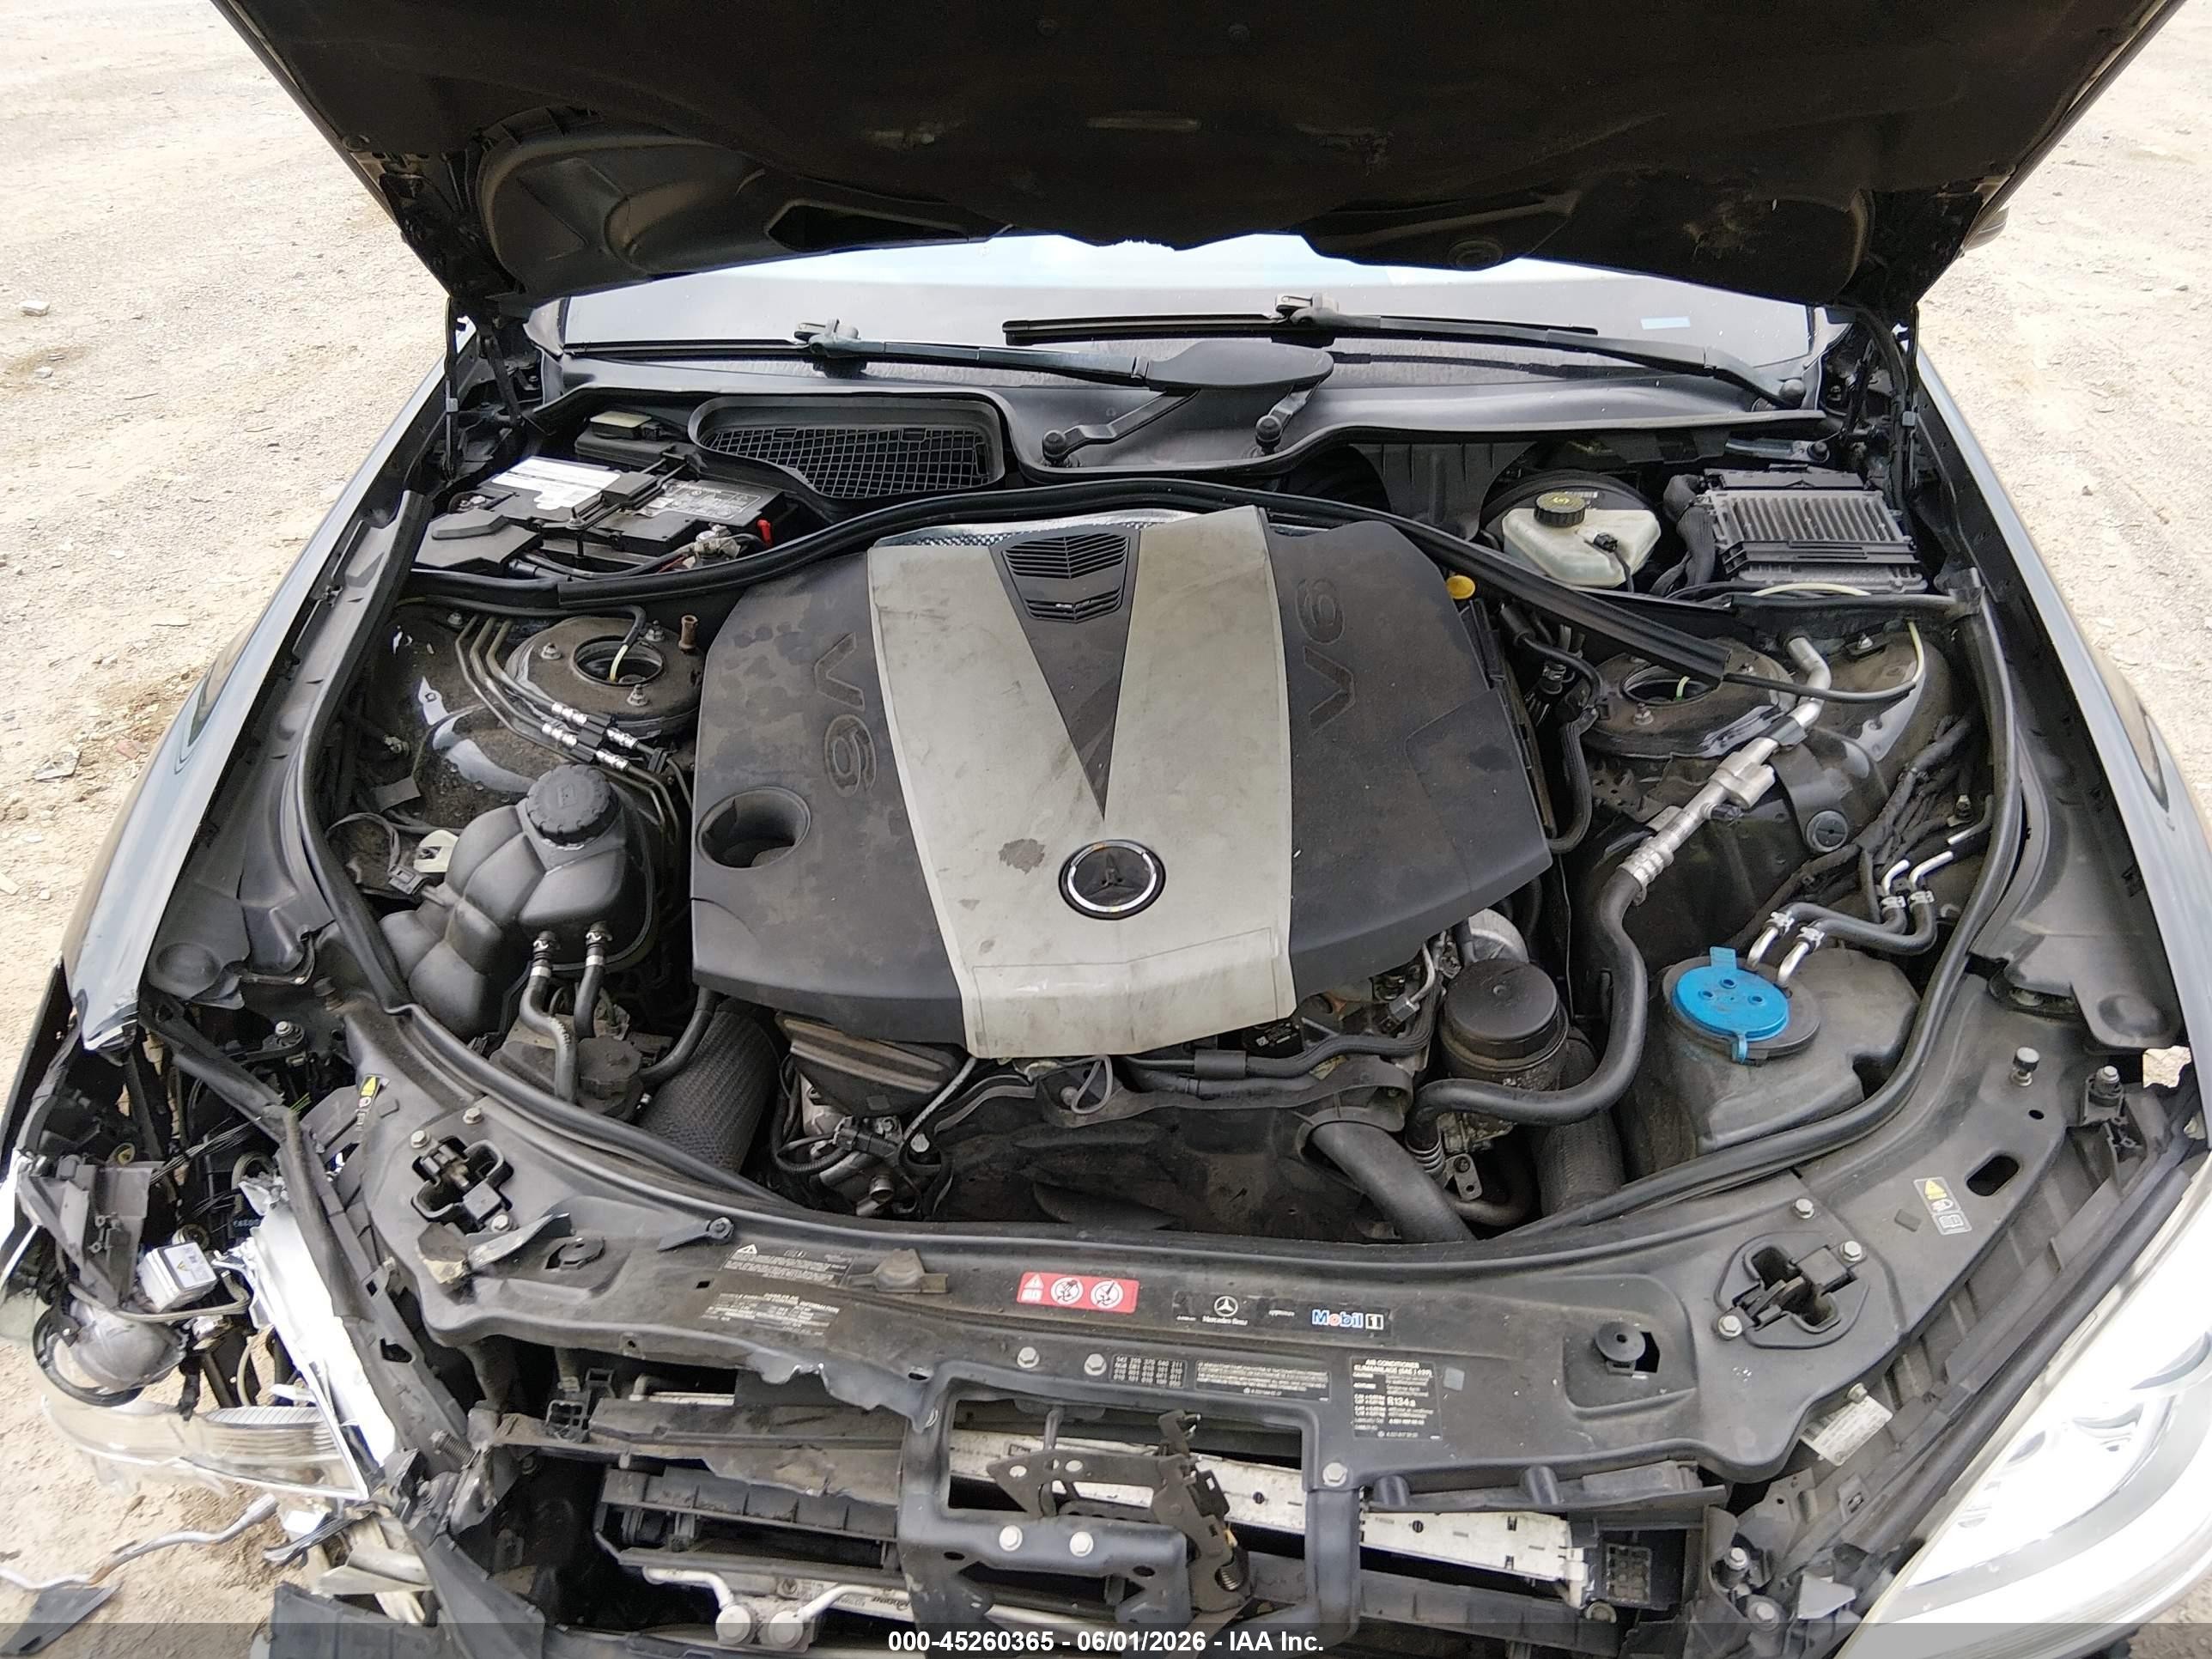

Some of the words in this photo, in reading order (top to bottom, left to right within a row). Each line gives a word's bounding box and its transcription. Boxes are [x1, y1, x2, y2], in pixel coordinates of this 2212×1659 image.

[814, 632, 877, 798] V6
[1296, 579, 1355, 736] V6
[1311, 1309, 1364, 1328] Mobil
[1365, 1313, 1384, 1330] 1
